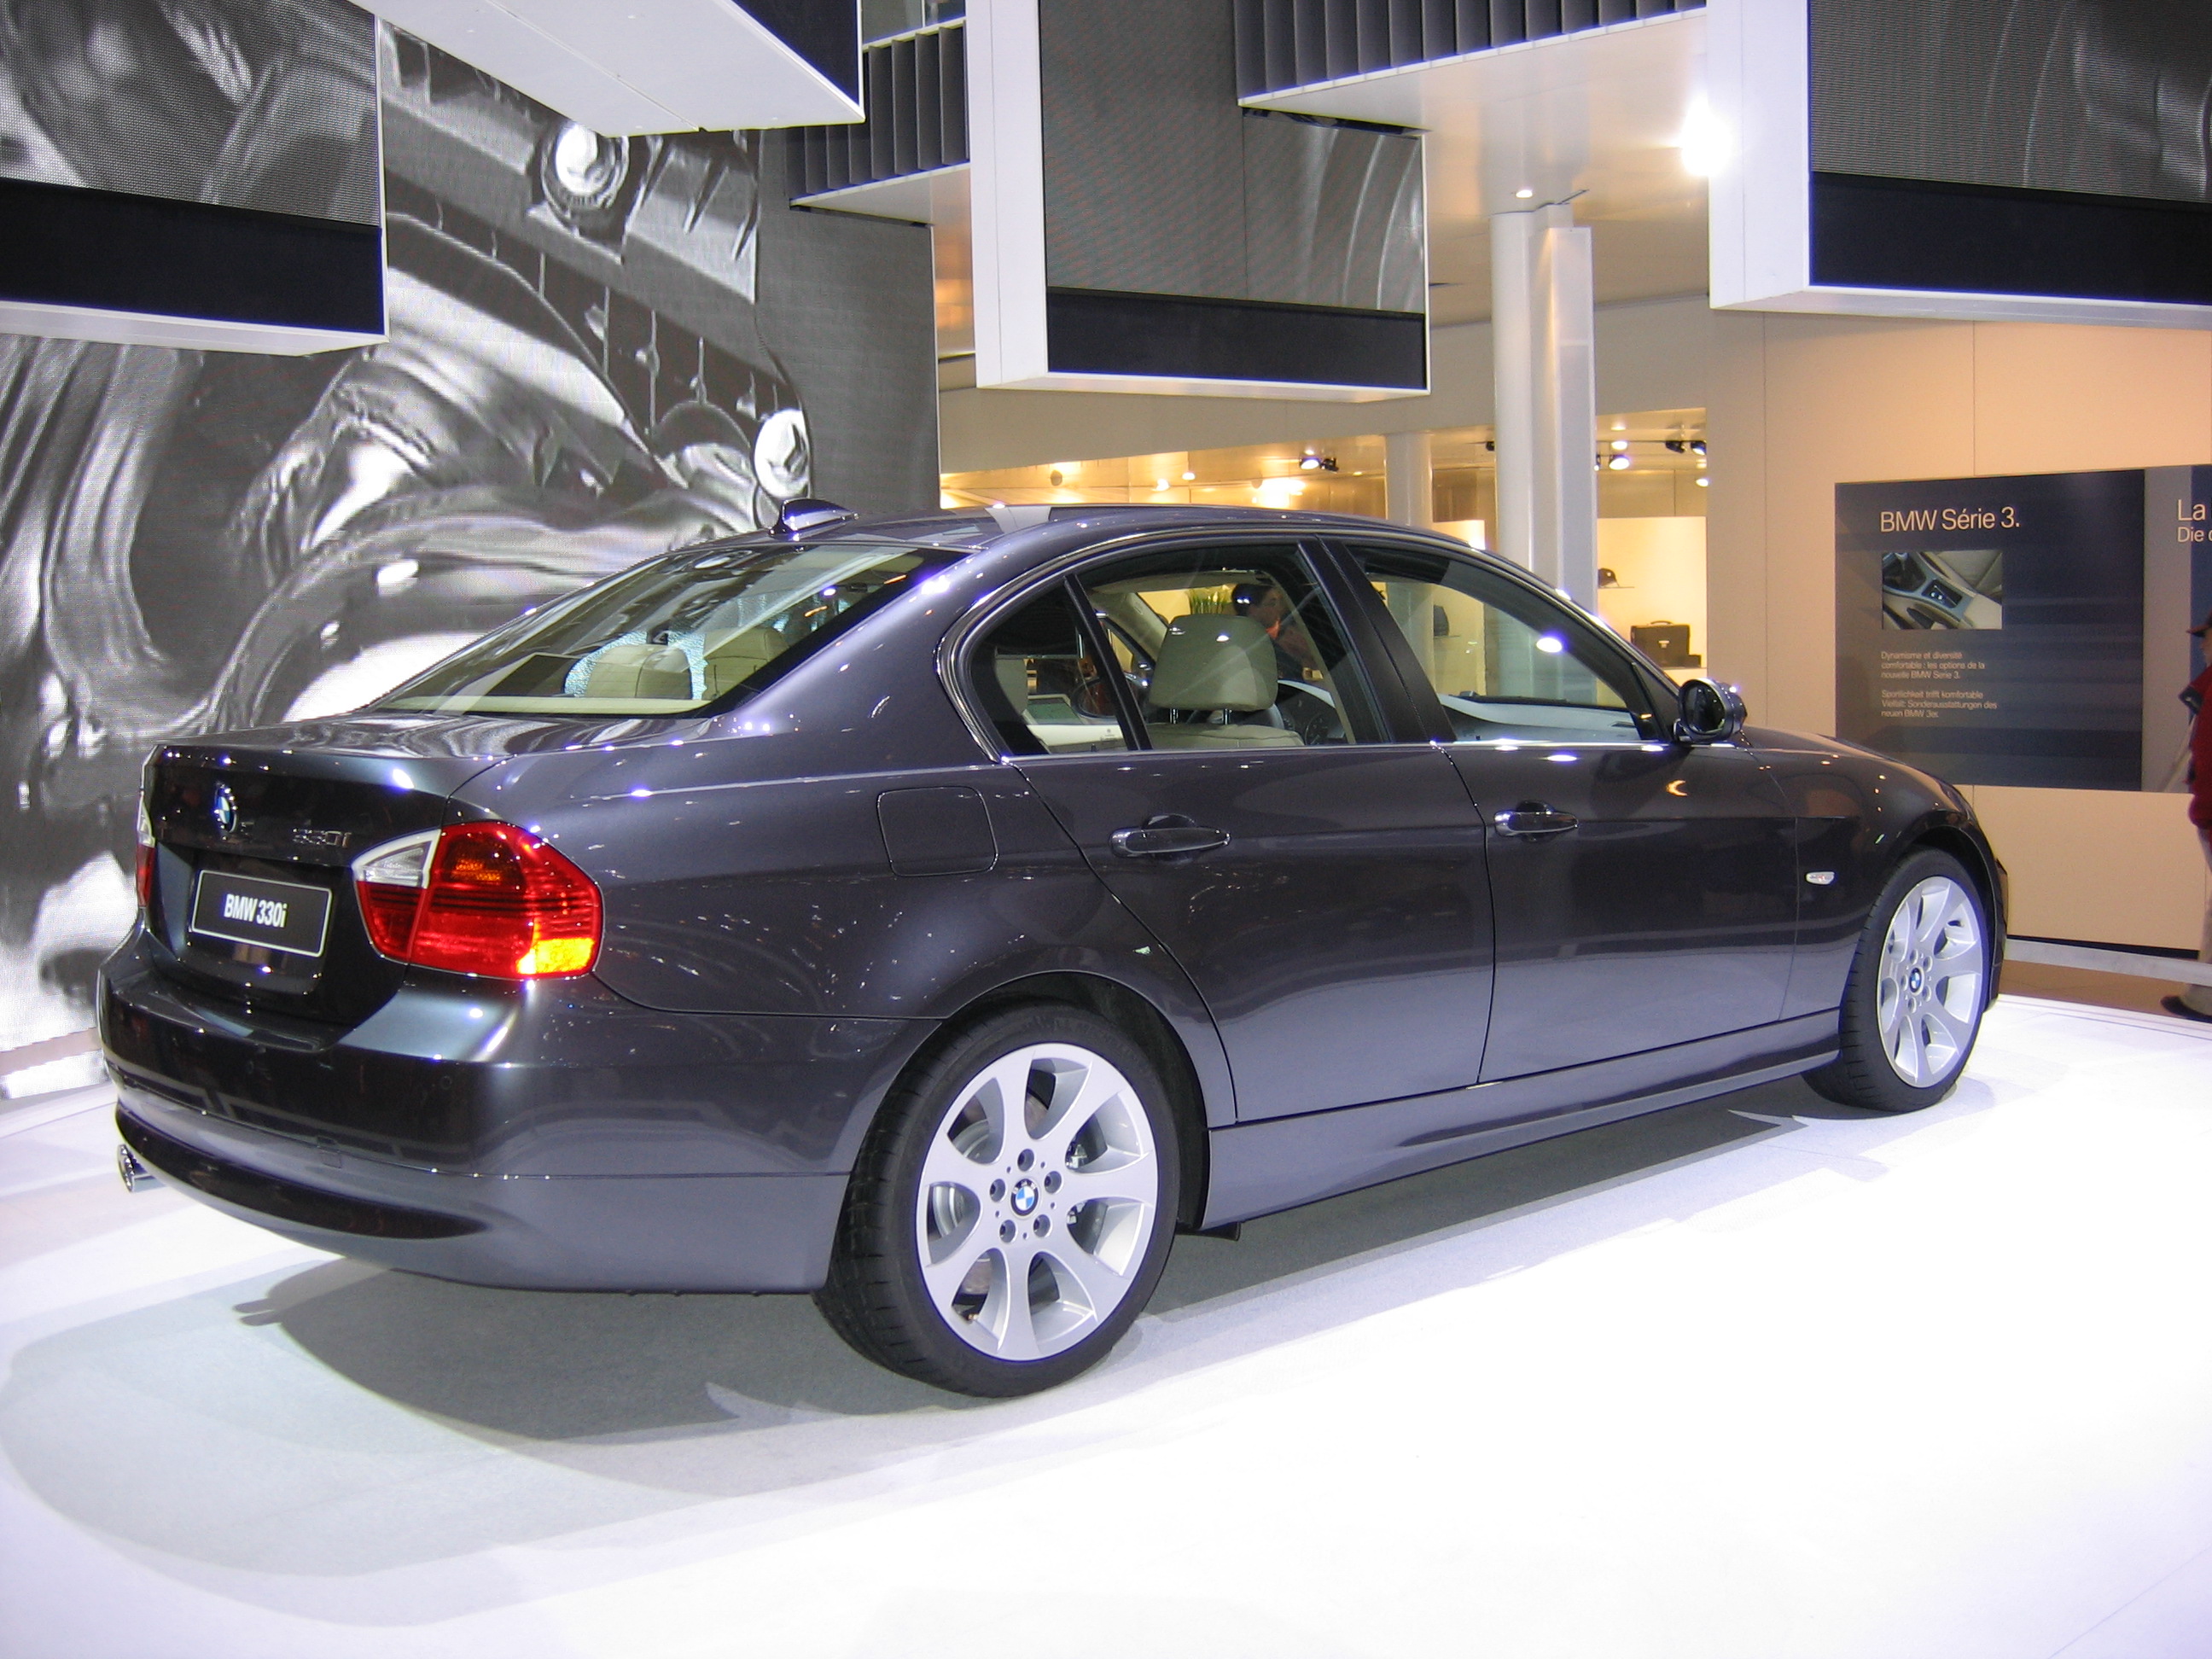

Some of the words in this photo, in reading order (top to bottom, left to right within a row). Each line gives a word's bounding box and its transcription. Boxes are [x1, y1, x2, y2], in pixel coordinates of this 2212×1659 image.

[2178, 499, 2206, 521] La
[1880, 509, 1938, 533] BMW
[1942, 507, 1995, 531] Série
[2000, 506, 2020, 528] 3.
[2177, 526, 2204, 543] Die
[1939, 662, 1965, 671] options
[1941, 690, 1984, 699] komfortable
[1904, 709, 1925, 718] BMW
[223, 893, 258, 923] BMW
[256, 899, 288, 928] 330i
